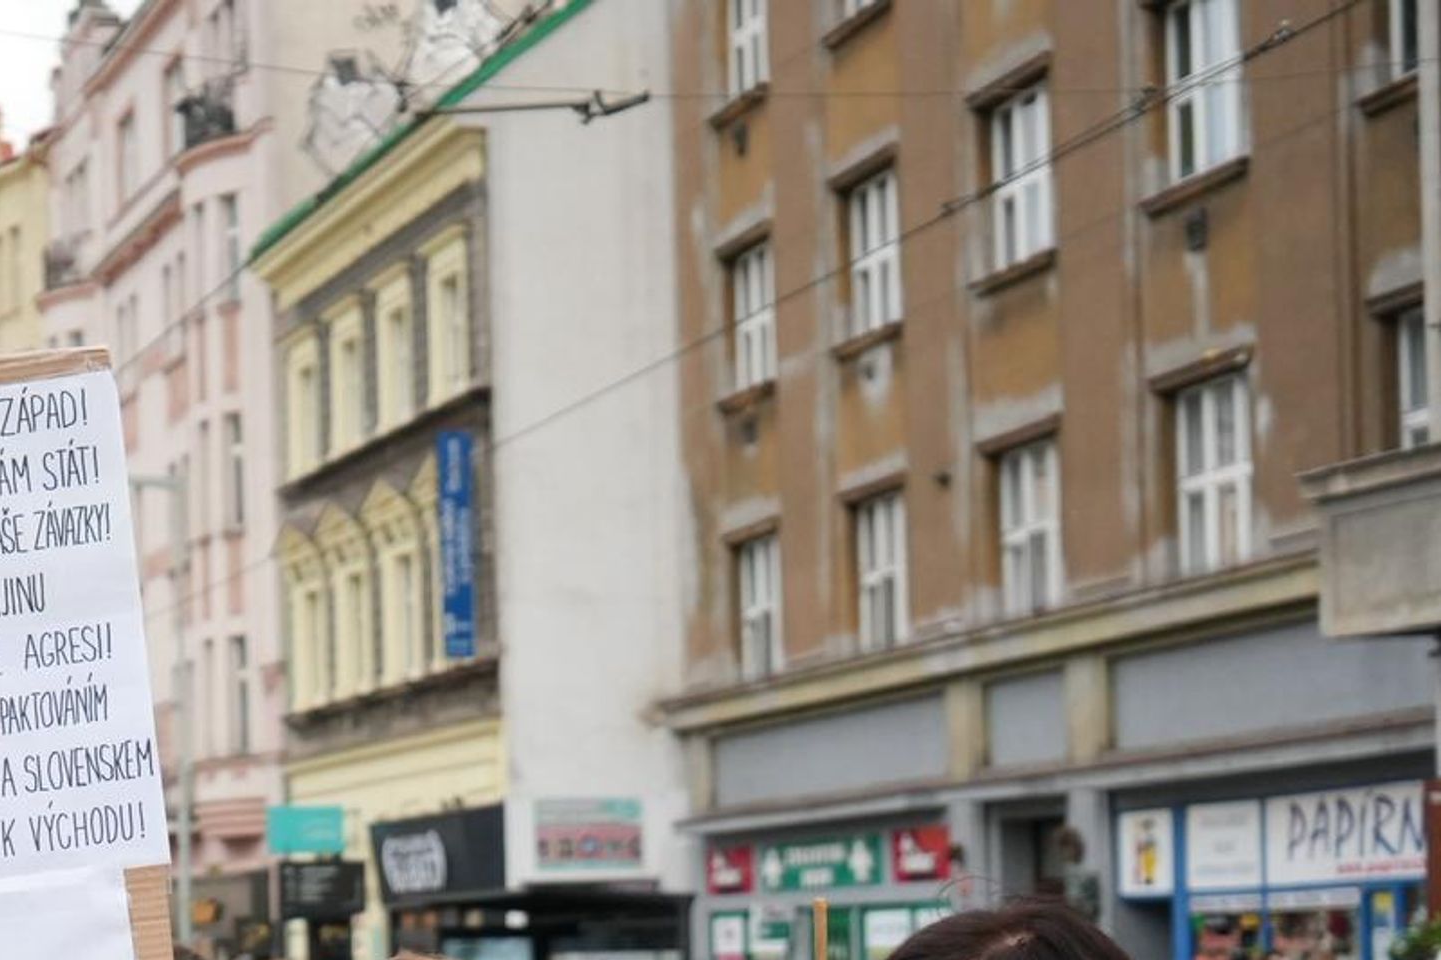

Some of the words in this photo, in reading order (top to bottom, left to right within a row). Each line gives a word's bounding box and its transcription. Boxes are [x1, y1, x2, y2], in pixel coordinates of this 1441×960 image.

[42, 438, 99, 491] STÁT!
[33, 500, 110, 550] ZÁVAZKY!
[24, 622, 111, 671] AGRESI!
[0, 672, 107, 735] PAKTOVÁNÍM
[2, 757, 17, 797] A
[24, 738, 154, 793] SLOVENSKEM
[2, 818, 15, 857] K
[29, 800, 145, 851] VÝCHODU!
